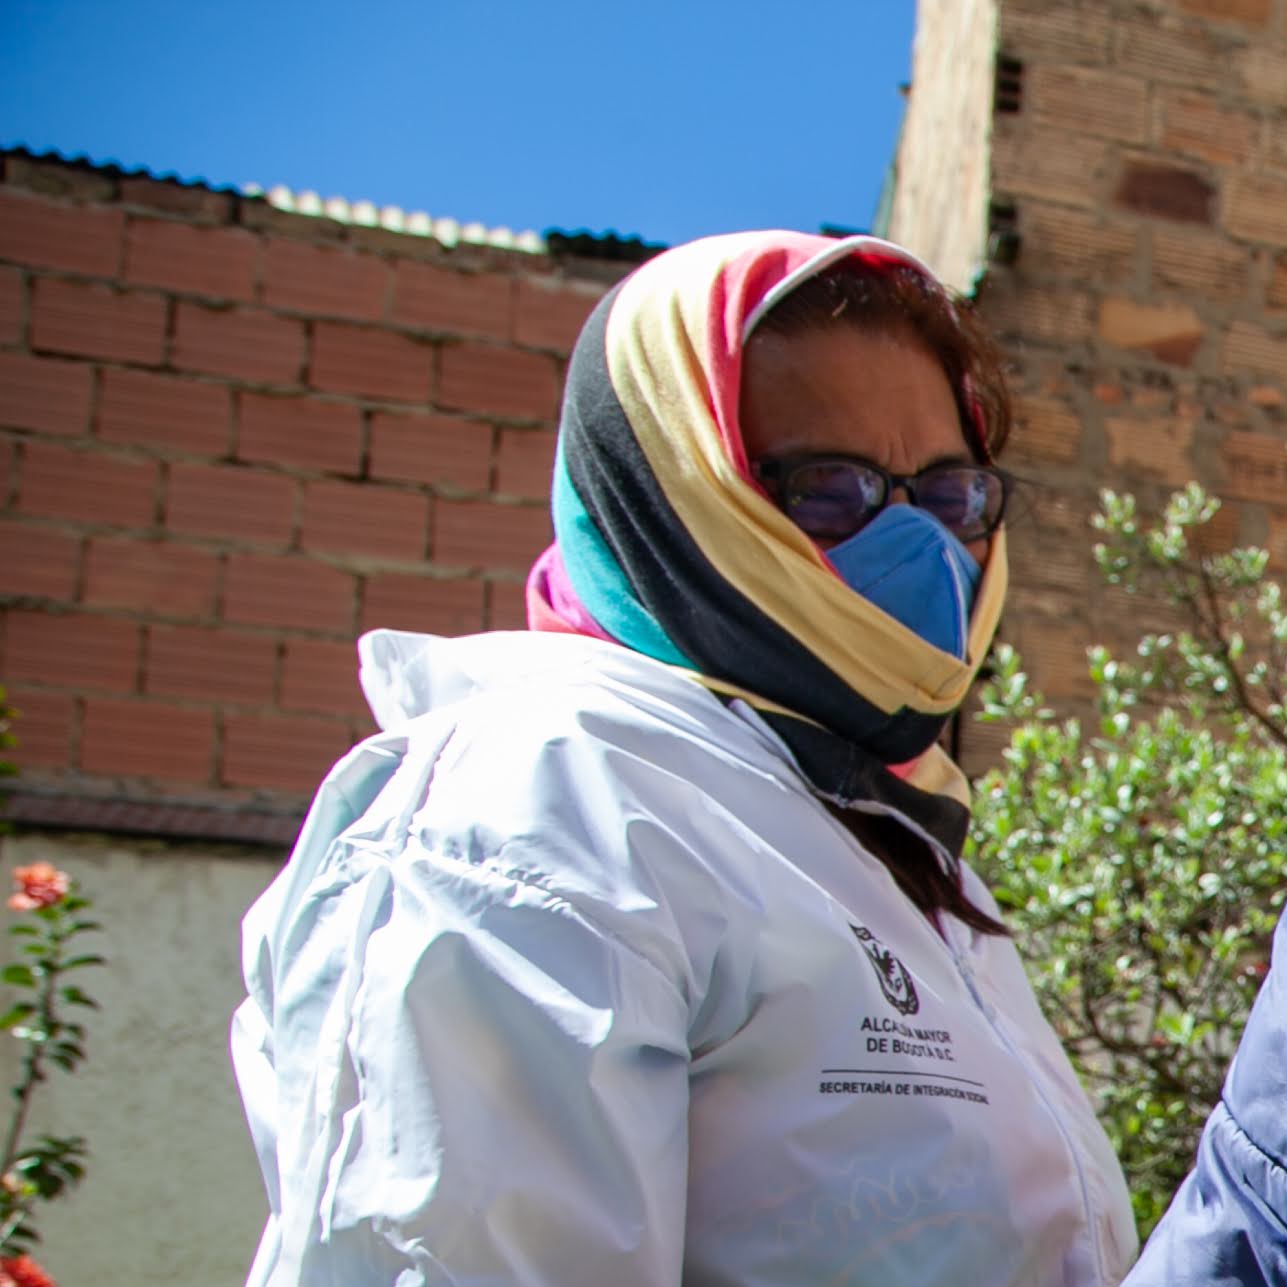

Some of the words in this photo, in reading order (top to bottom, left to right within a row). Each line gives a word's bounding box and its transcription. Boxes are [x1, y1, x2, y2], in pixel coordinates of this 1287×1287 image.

[914, 1029, 952, 1044] MAYOR
[866, 1038, 888, 1053] DE
[819, 1080, 892, 1095] SECRETARÍA
[895, 1084, 910, 1095] DE
[913, 1085, 966, 1099] INTEGRACIÓN
